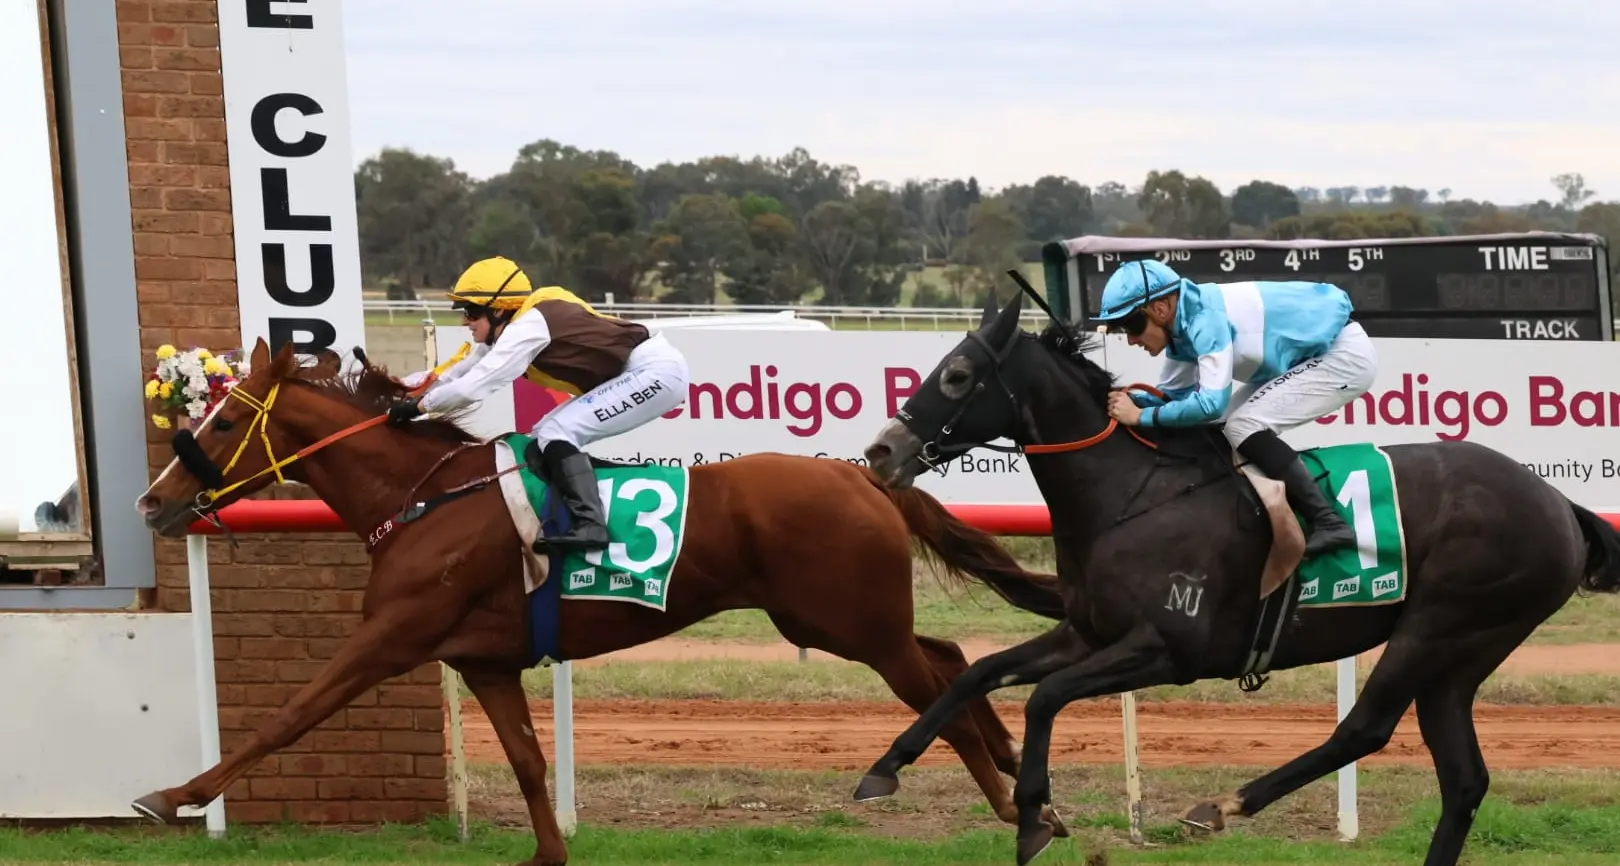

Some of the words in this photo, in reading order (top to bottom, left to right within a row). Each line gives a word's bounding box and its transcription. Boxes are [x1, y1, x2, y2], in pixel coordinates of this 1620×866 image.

[250, 92, 342, 376] CLUB
[1219, 249, 1256, 272] 3RD
[1284, 248, 1320, 272] 4TH
[1347, 248, 1384, 271] 5TH
[1478, 246, 1549, 270] TIME
[1500, 319, 1580, 339] TRACK
[594, 400, 633, 422] ELLA
[630, 379, 662, 405] BEN
[1314, 373, 1508, 441] ndigo
[961, 453, 1020, 473] Bank
[1336, 470, 1378, 570] 1
[572, 574, 593, 584] TAB
[613, 575, 631, 585] TAB
[1336, 582, 1357, 593] TAB
[1374, 579, 1396, 590] TAB
